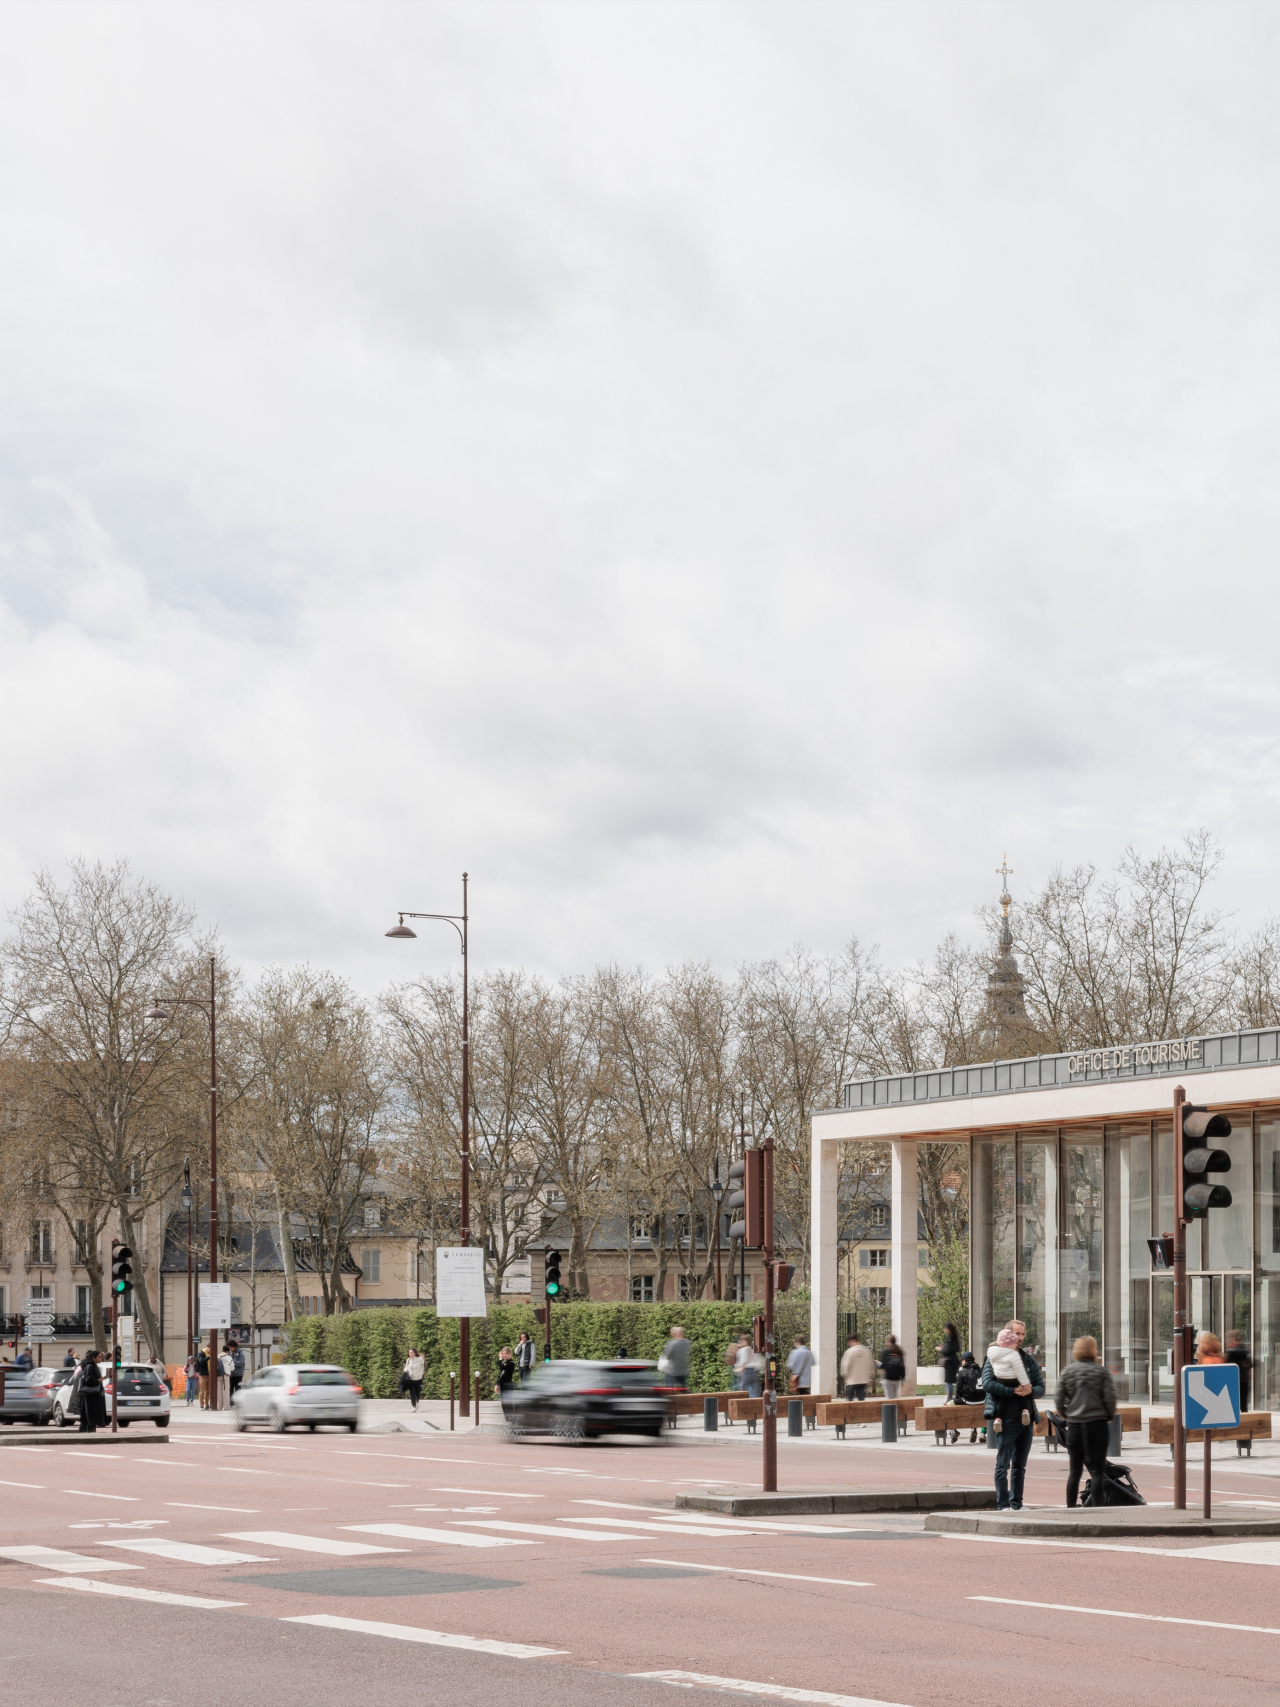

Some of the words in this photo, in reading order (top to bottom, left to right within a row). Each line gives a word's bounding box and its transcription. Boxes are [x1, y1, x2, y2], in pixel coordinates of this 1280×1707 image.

[1067, 1051, 1110, 1074] OFFICE
[1113, 1049, 1130, 1069] DE
[1133, 1040, 1201, 1066] TOURISME
